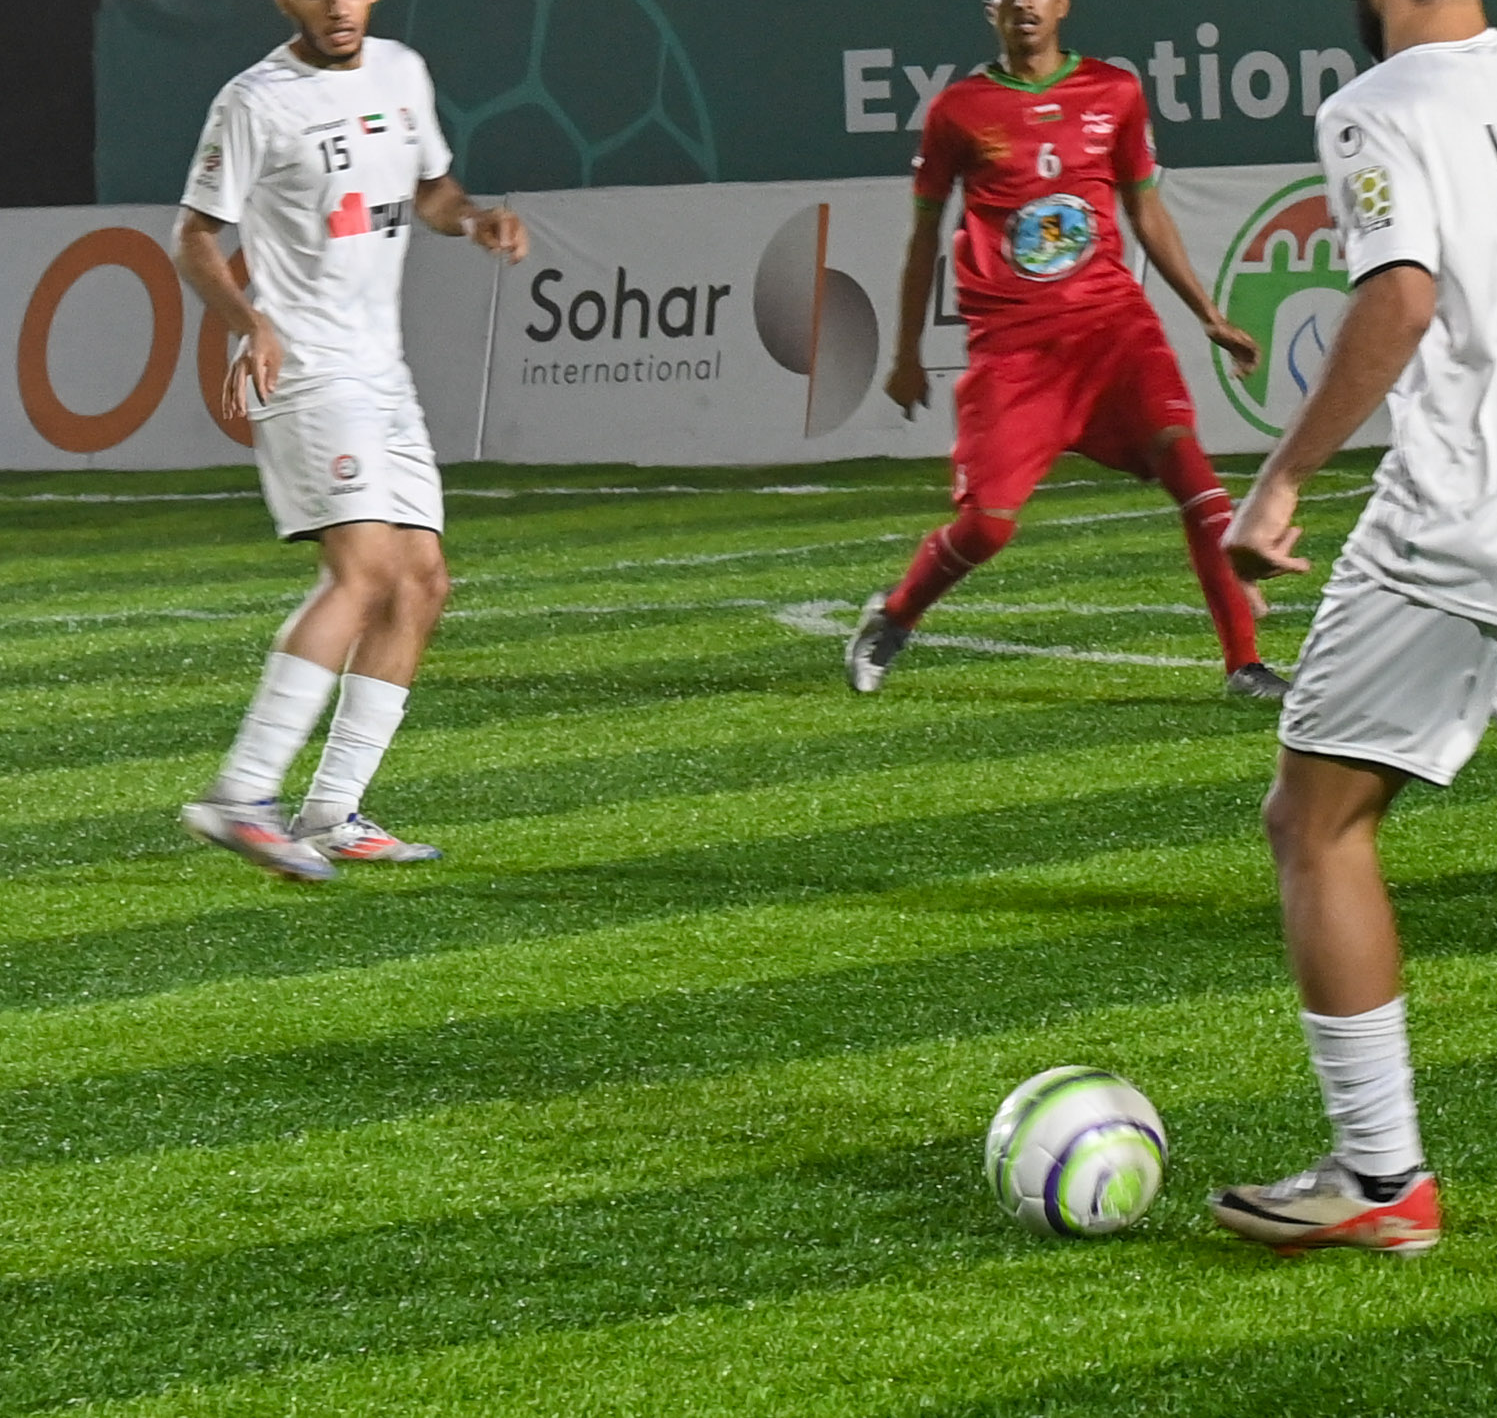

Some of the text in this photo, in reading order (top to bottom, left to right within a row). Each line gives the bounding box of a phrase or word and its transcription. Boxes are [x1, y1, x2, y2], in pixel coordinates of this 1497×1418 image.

[843, 22, 1357, 134] Extion
[319, 135, 352, 173] 15
[1036, 142, 1062, 179] 6
[525, 266, 731, 342] Sohar
[522, 350, 722, 384] international
